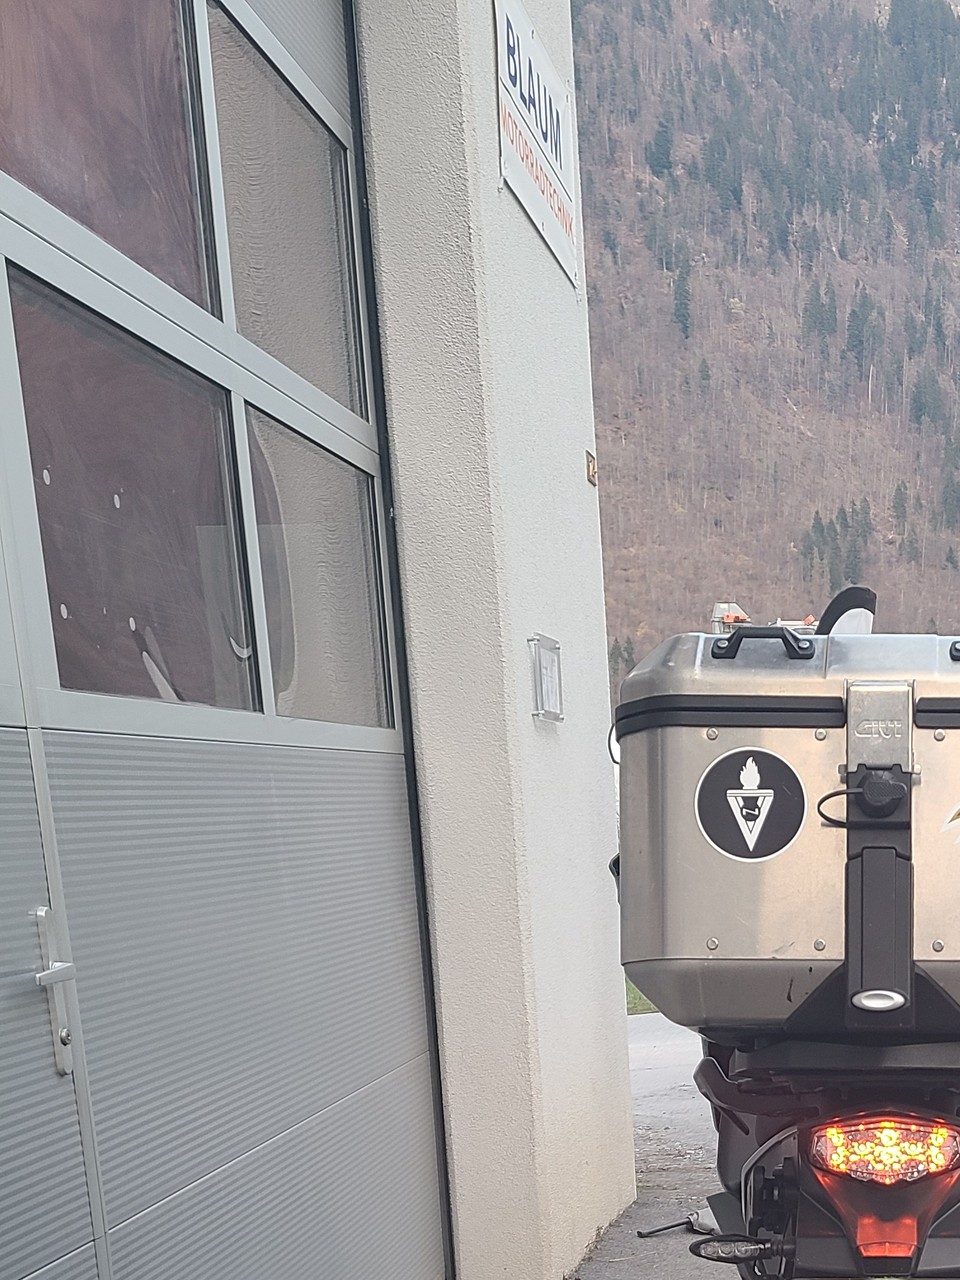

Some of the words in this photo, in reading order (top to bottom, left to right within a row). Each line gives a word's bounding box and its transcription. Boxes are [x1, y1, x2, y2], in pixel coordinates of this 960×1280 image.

[506, 13, 562, 170] BLAUM
[500, 100, 575, 245] MOTORRADTECHNIK
[855, 719, 902, 738] GIVI
